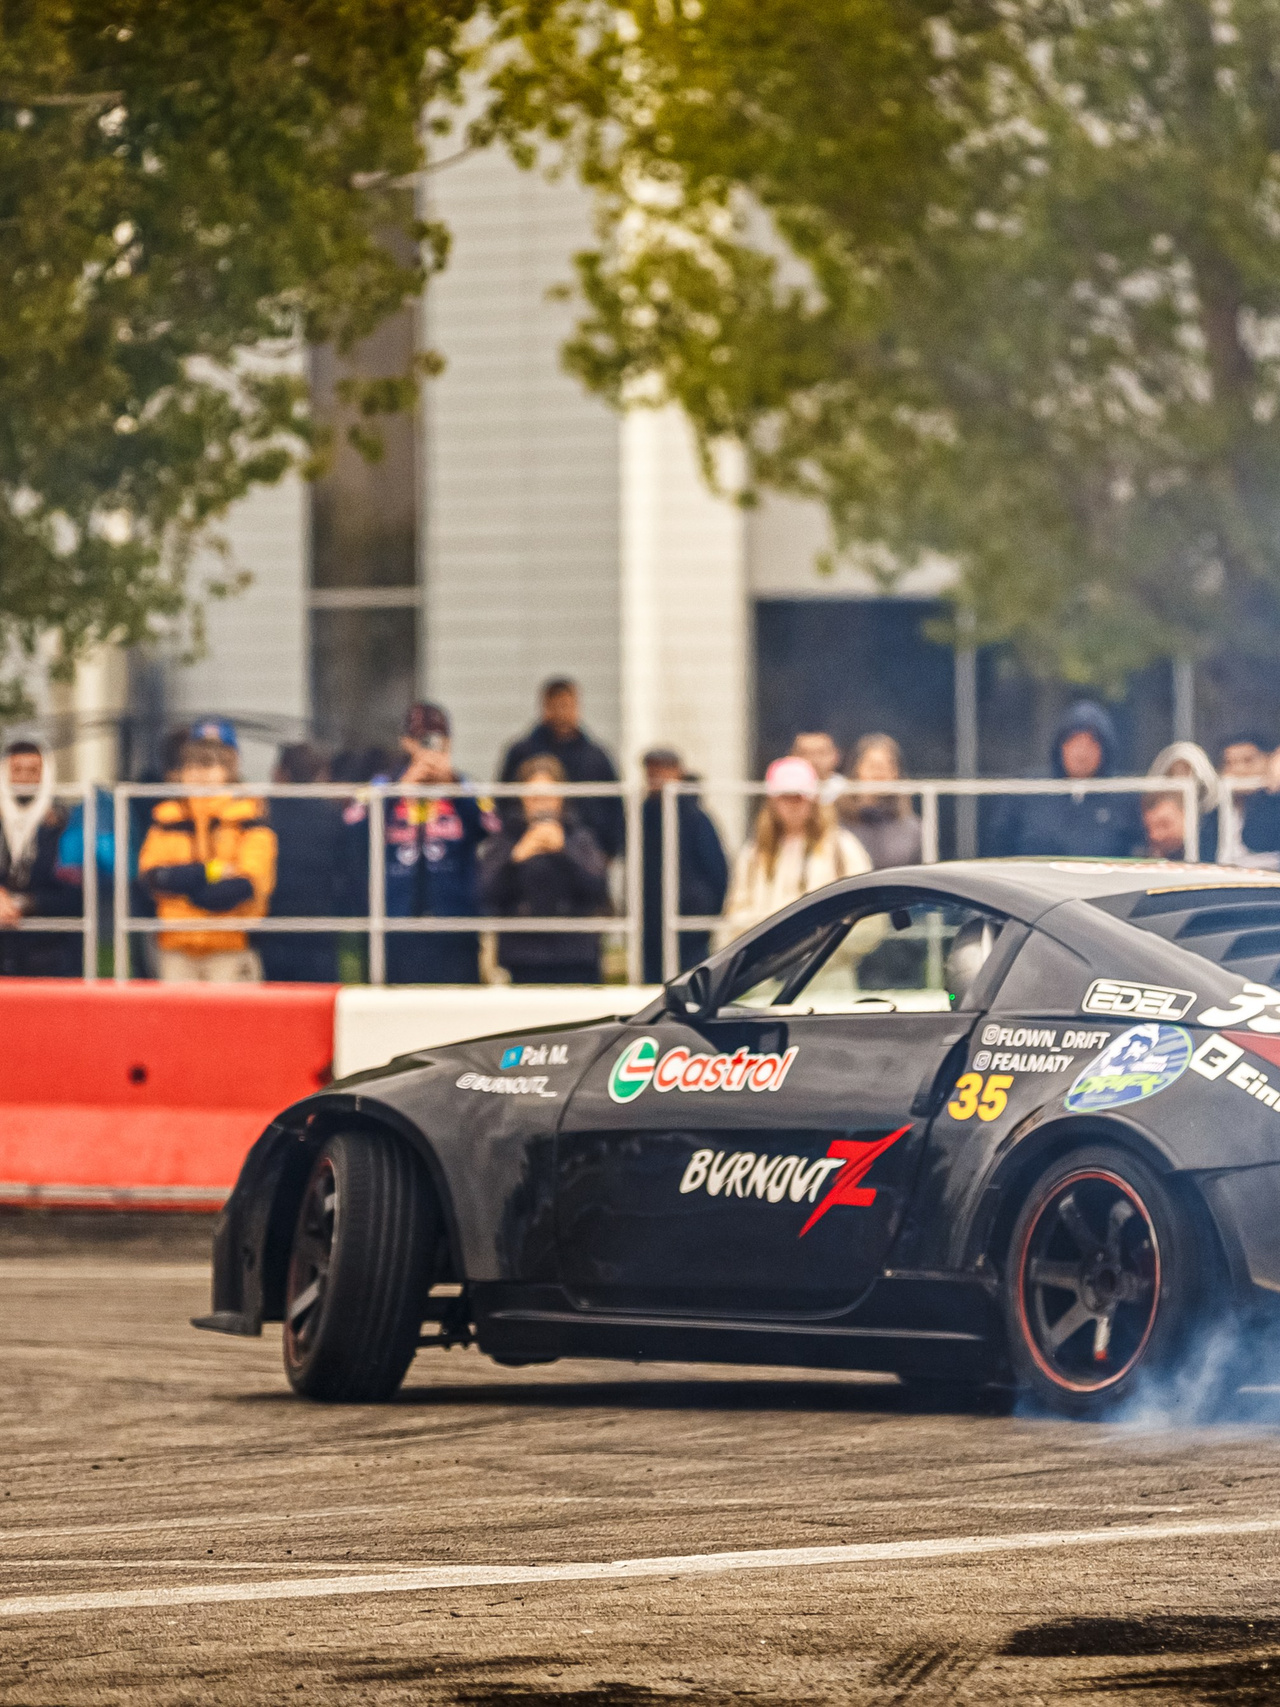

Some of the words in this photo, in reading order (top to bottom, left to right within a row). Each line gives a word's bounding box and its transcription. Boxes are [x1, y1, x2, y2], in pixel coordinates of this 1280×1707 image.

[1088, 983, 1182, 1017] EDEL
[653, 1045, 799, 1092] Castrol
[948, 1072, 1015, 1122] 35
